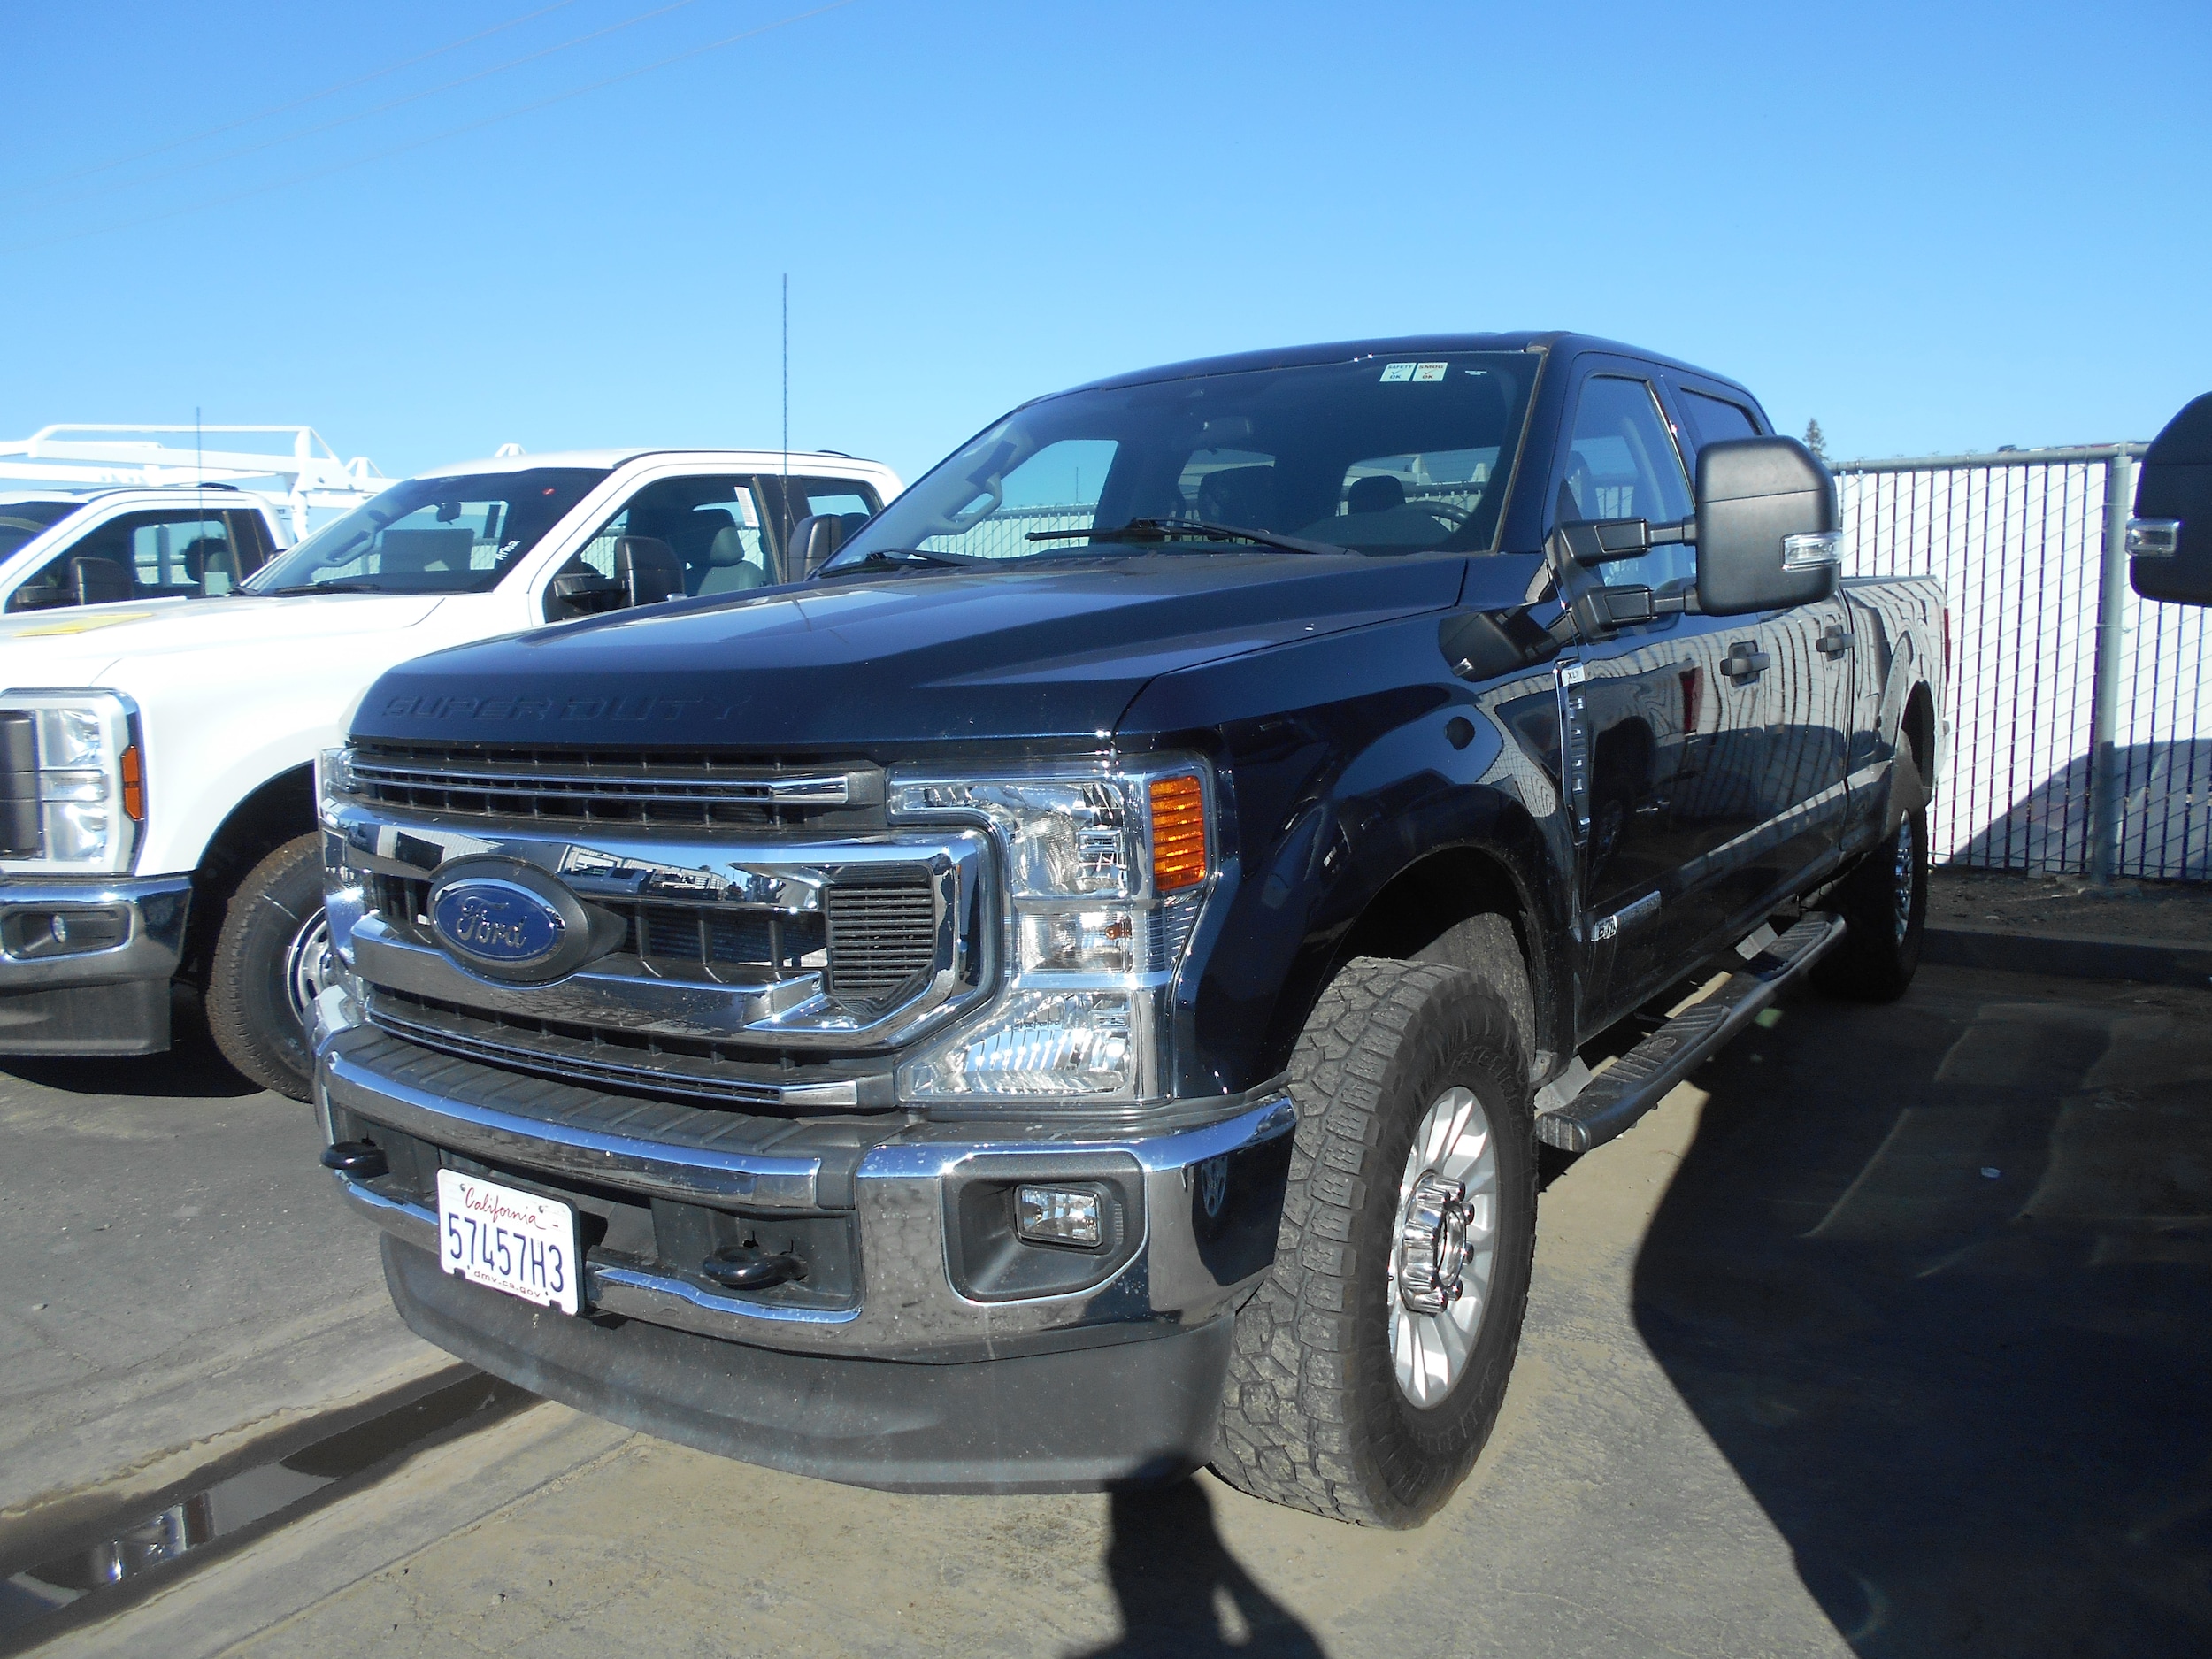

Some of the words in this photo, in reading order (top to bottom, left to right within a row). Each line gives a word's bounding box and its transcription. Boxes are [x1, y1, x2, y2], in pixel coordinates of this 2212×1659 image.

[1567, 670, 1579, 680] XLT
[382, 695, 556, 721] SUPER
[559, 694, 754, 721] DUTY
[456, 895, 528, 949] Ford
[465, 1187, 547, 1231] California
[448, 1211, 565, 1293] 57457H3
[473, 1269, 541, 1298] dmv.ca.gov
